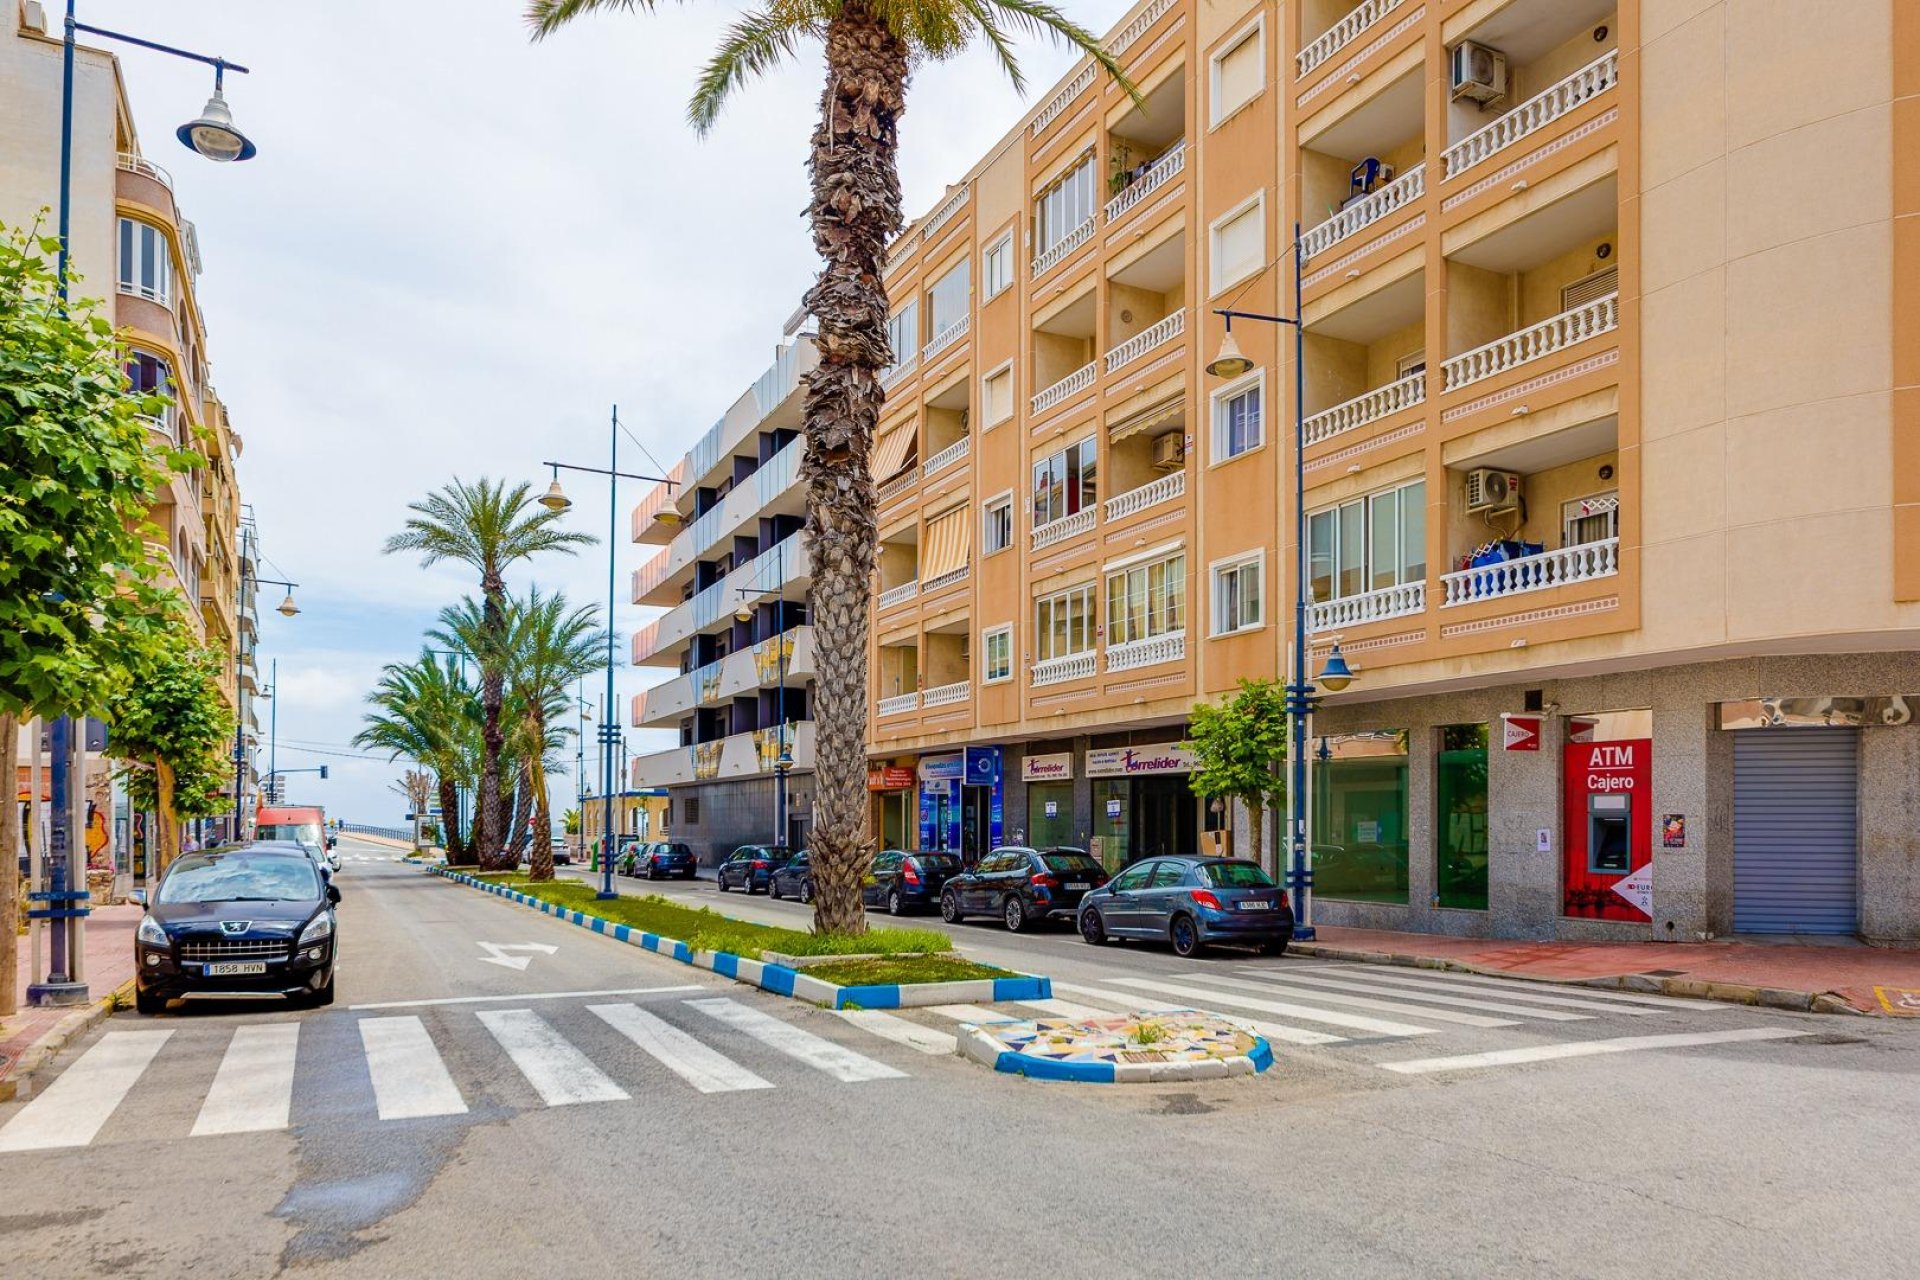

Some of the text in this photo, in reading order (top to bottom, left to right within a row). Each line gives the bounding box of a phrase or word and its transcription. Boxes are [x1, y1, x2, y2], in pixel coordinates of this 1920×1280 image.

[1589, 746, 1633, 766] ATM
[1587, 773, 1634, 792] Cajero
[214, 963, 263, 973] 1858 HVN
